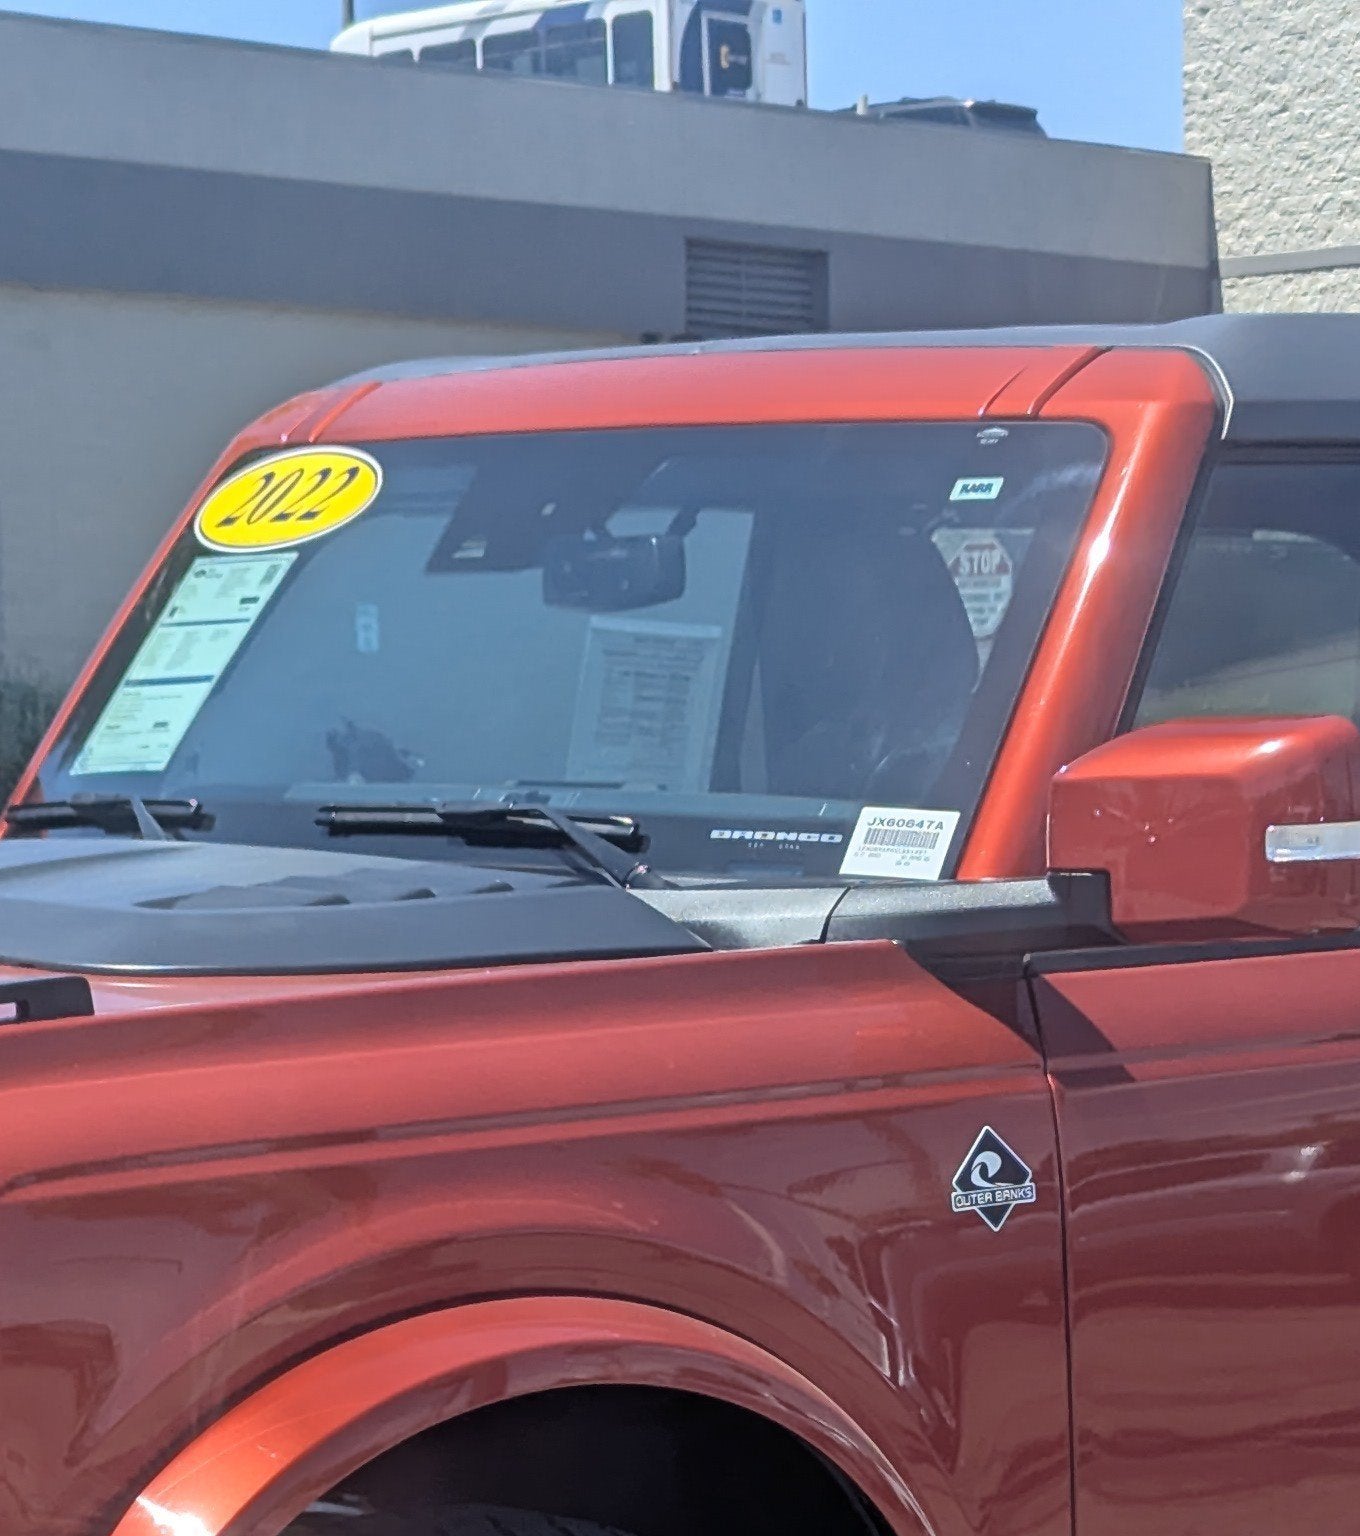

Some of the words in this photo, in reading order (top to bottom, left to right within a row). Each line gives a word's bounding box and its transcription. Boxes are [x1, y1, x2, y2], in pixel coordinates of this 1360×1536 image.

[215, 466, 360, 528] 2022
[960, 551, 1001, 575] STOP
[710, 829, 843, 843] BRONCO
[954, 1192, 992, 1207] OUTER
[994, 1187, 1033, 1202] BANKS
